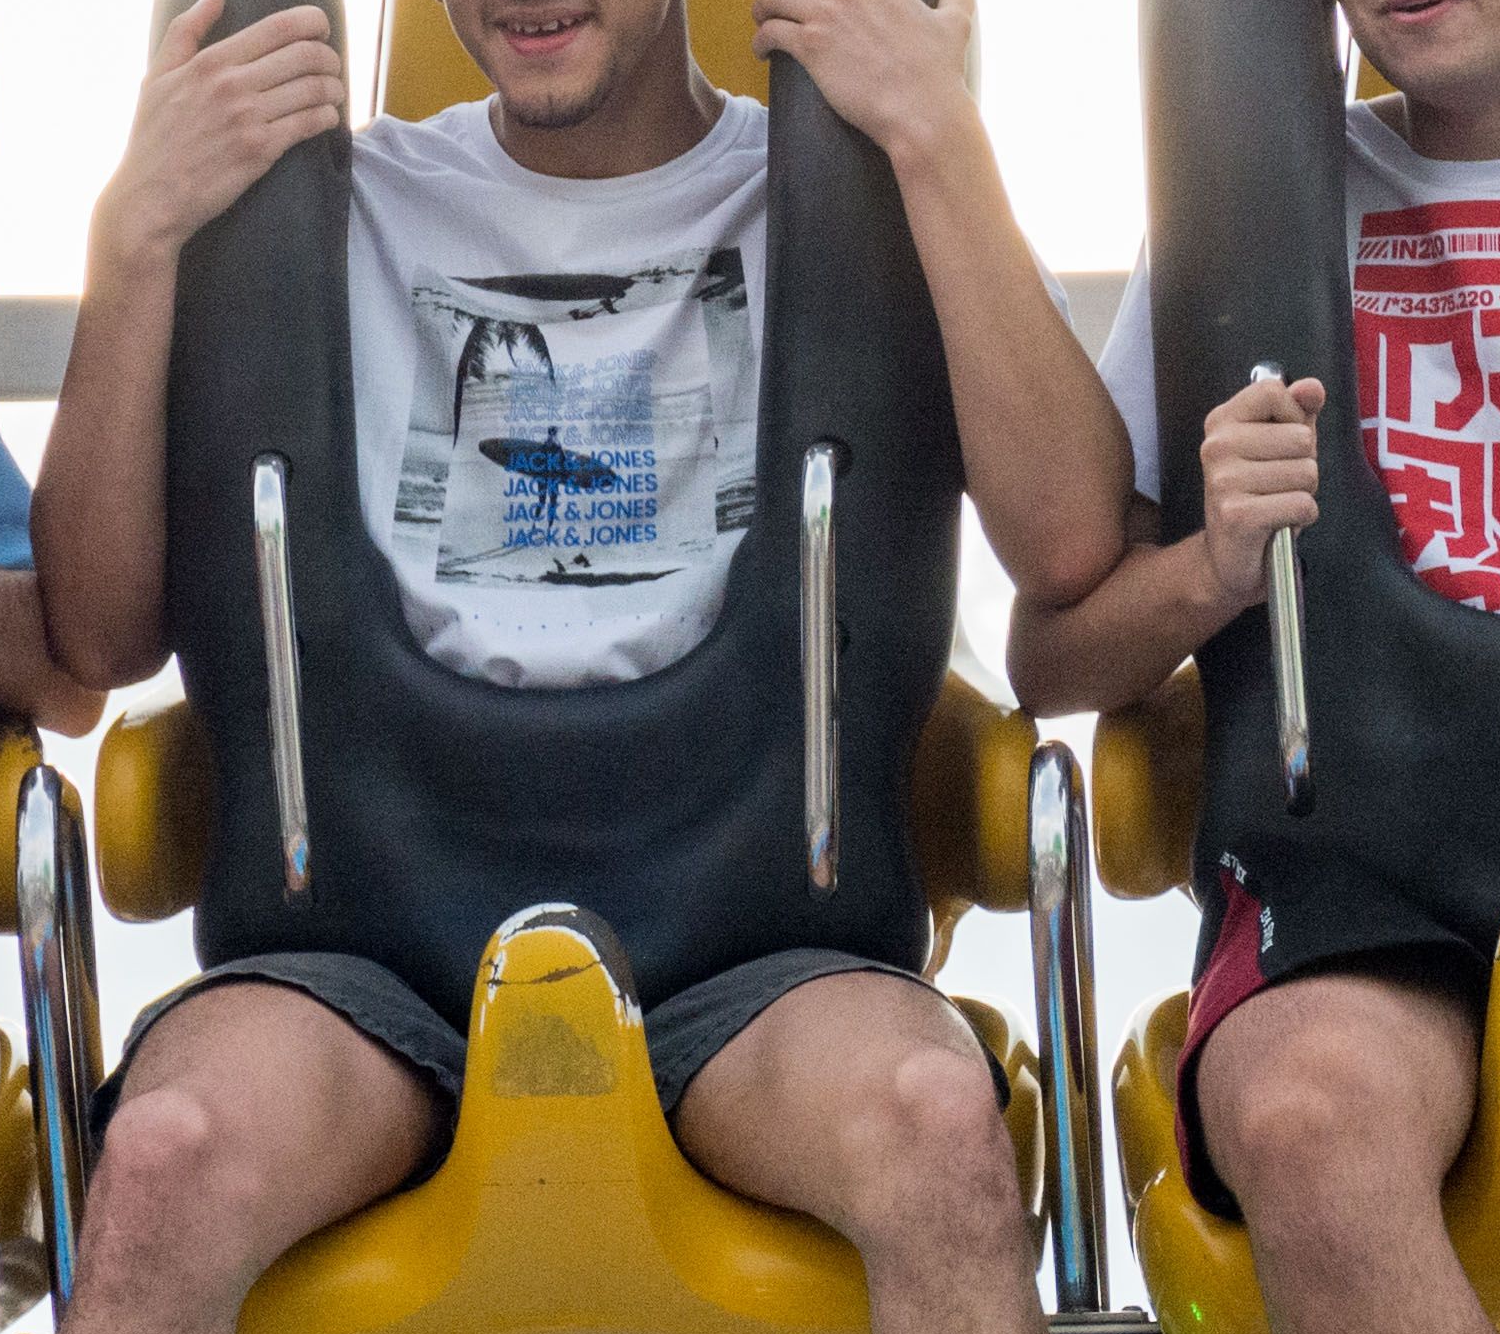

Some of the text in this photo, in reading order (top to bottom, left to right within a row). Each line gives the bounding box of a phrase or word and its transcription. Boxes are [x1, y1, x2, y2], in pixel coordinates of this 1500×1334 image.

[563, 425, 582, 446] &
[505, 449, 657, 472] JACK & JONES
[503, 473, 658, 498] JACK & JONES
[503, 498, 658, 523] JACK & JONES
[502, 524, 657, 548] JACK & JONES
